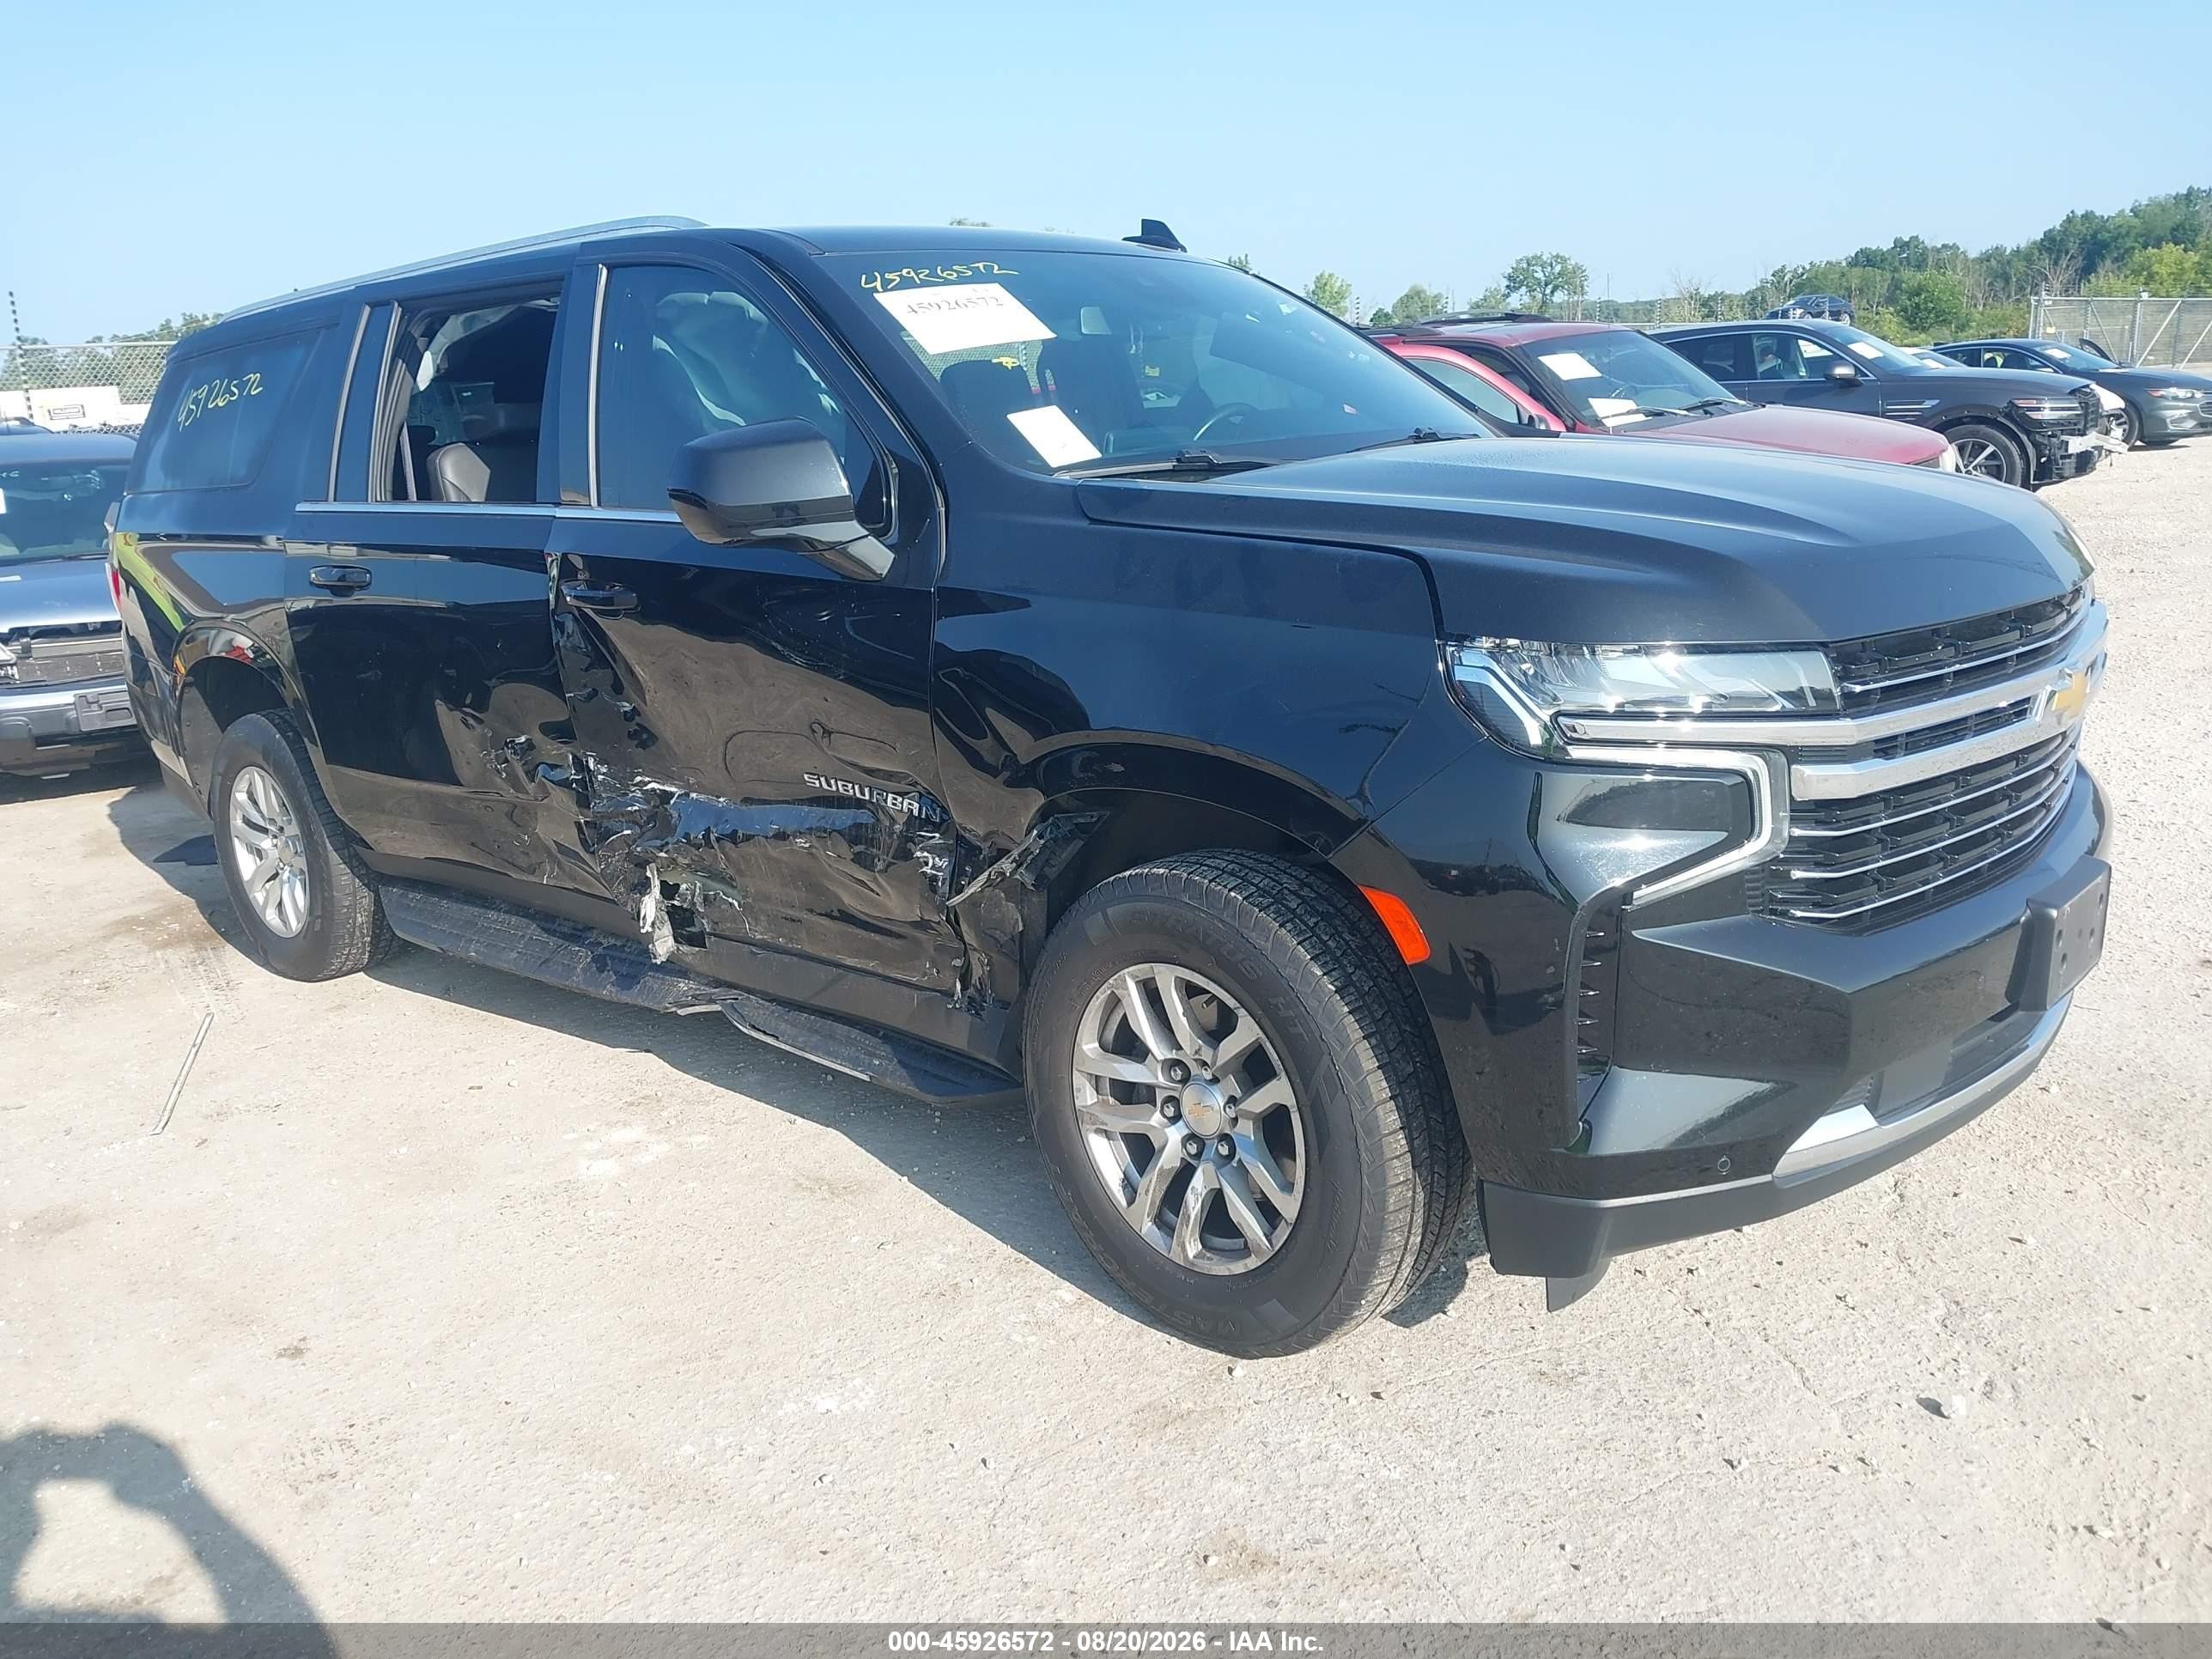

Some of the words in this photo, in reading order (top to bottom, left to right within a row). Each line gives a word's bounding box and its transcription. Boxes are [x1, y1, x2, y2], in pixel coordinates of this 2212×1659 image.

[860, 261, 1019, 291] 45926572
[177, 373, 264, 432] 45926572
[803, 773, 941, 823] SUBURBAN
